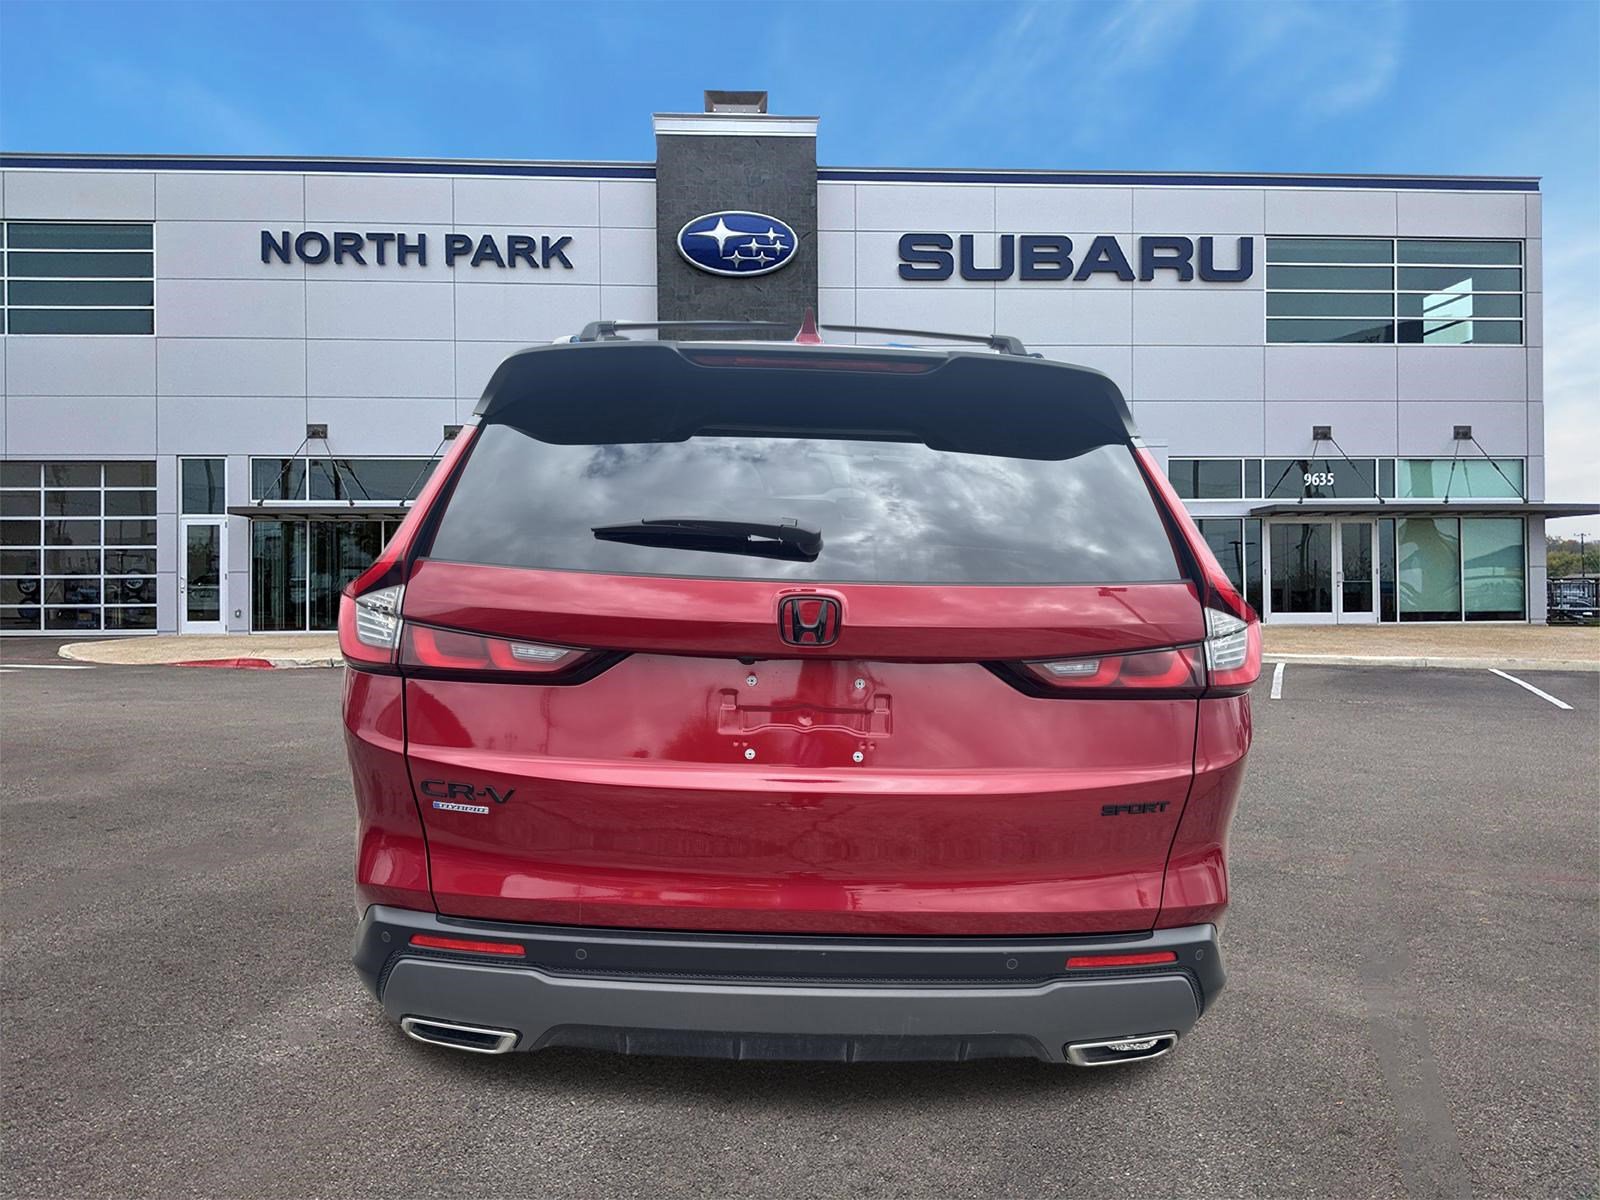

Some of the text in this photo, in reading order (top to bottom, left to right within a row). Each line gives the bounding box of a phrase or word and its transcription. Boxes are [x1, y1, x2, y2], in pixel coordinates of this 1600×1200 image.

[261, 230, 574, 269] NORTH PARK
[898, 232, 1254, 282] SUBARU
[1303, 472, 1335, 486] 9635
[421, 779, 516, 804] CR-V
[1101, 801, 1170, 816] SPORT
